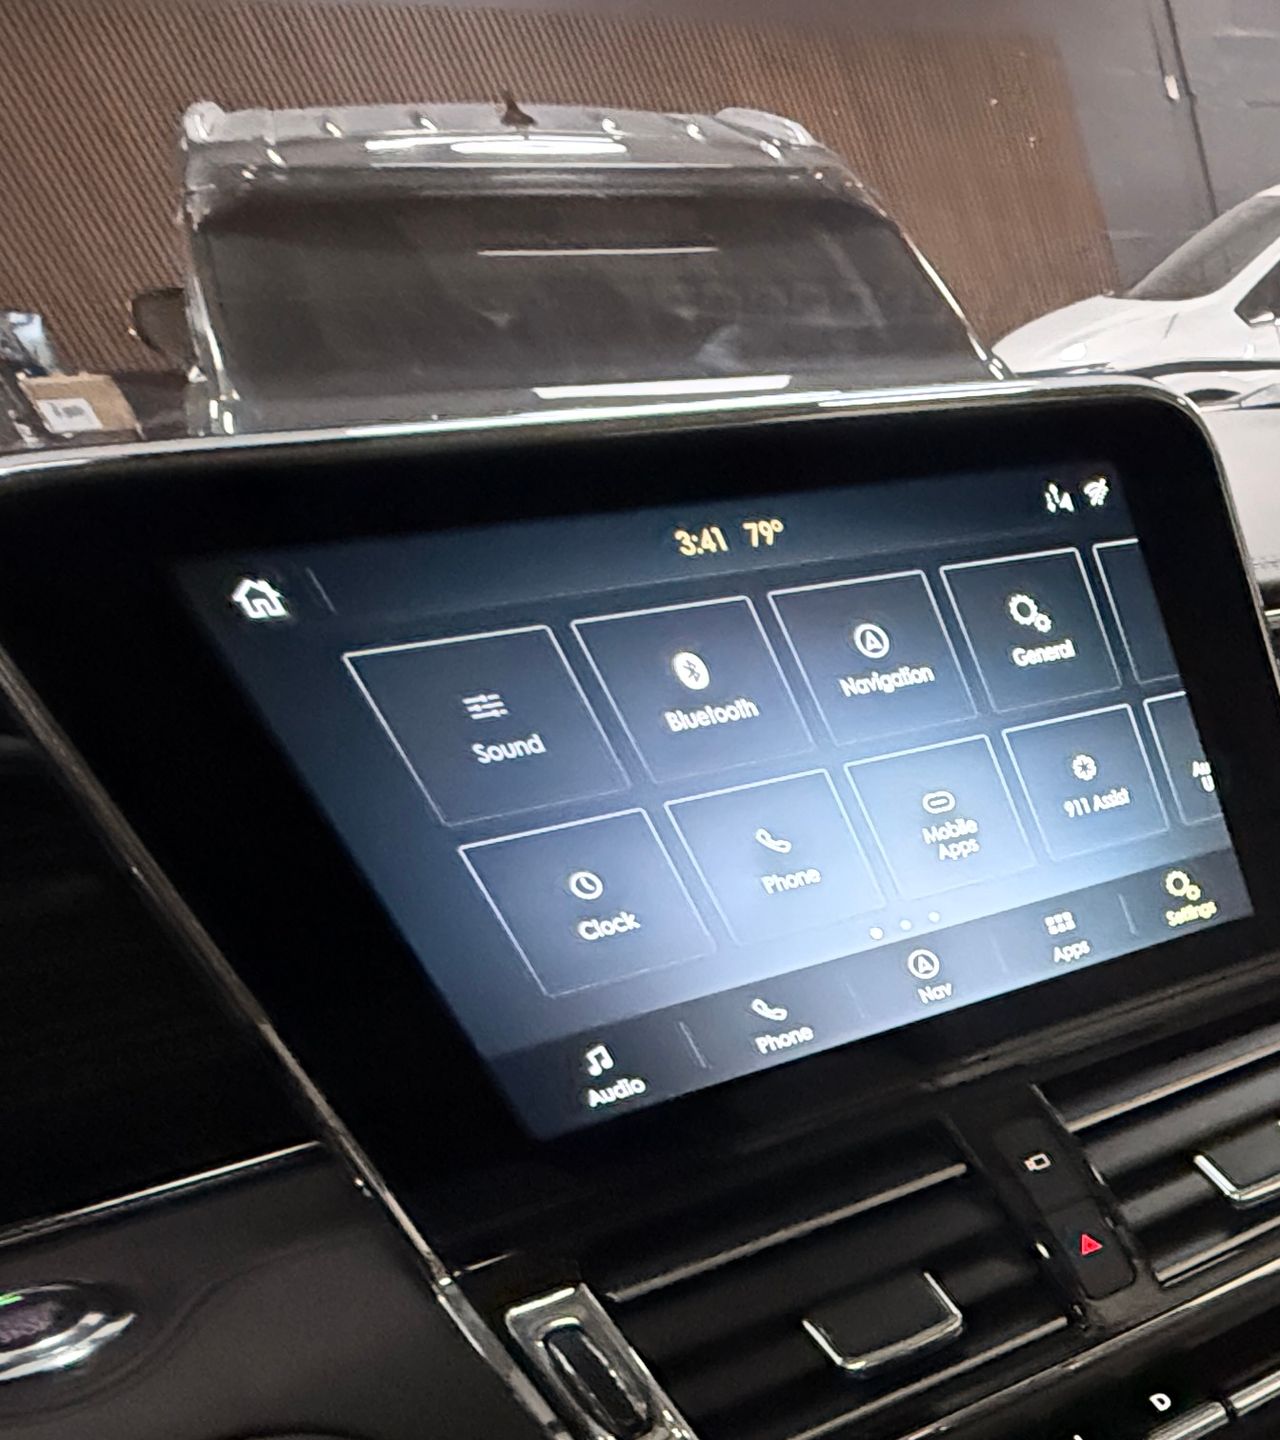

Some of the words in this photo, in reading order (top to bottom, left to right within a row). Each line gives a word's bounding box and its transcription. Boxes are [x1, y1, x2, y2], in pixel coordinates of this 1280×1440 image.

[674, 525, 728, 556] 3:41
[1011, 640, 1076, 666] General
[839, 664, 935, 697] Navigation
[665, 699, 760, 732] Bluetooth
[472, 734, 546, 764] Sound
[1063, 800, 1092, 817] 911
[921, 818, 979, 844] Mobile
[938, 841, 980, 860] Apps
[761, 868, 821, 894] Phone
[578, 911, 642, 941] Clock
[1053, 940, 1091, 964] Apps
[917, 983, 952, 1005] Nav
[754, 1026, 814, 1055] Phone
[587, 1077, 647, 1108] Audio
[1149, 1393, 1173, 1412] D
